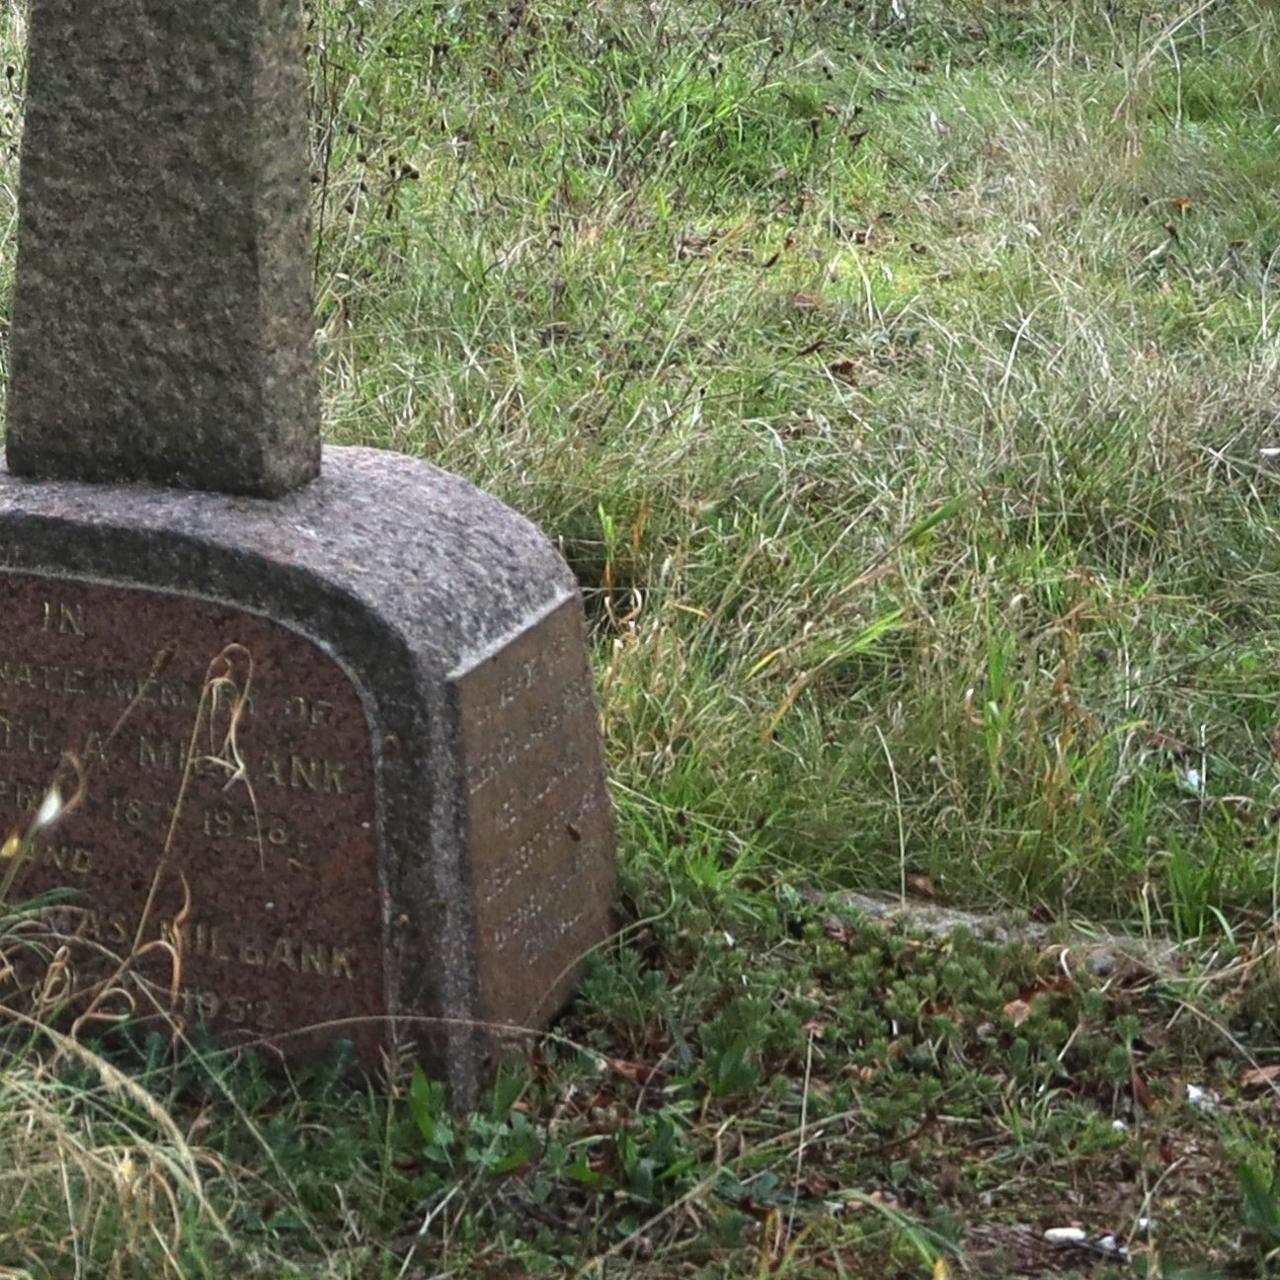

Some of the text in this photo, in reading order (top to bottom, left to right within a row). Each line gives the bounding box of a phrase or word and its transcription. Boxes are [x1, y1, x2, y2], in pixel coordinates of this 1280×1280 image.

[42, 599, 86, 637] IN
[283, 694, 335, 725] OF
[159, 920, 357, 982] MILBANK
